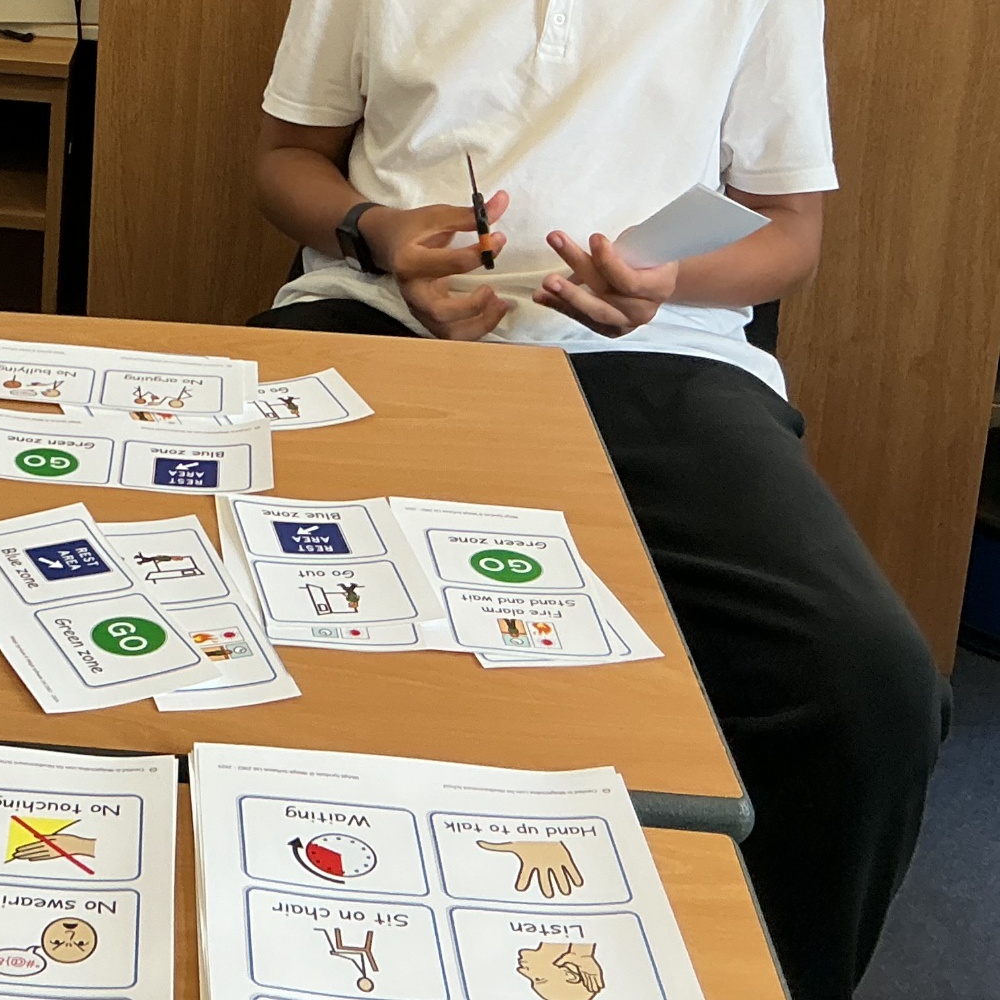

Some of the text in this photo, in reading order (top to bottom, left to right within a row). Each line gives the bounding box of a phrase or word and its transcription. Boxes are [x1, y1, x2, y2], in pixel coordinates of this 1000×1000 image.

[56, 369, 77, 378] No
[123, 373, 204, 386] No arguing
[270, 386, 289, 394] Go
[7, 434, 96, 450] Green zone
[150, 446, 225, 459] Blue zone
[23, 454, 71, 470] GO
[167, 469, 205, 478] AREA
[168, 478, 203, 486] REST
[262, 508, 341, 520] Blue zone
[292, 535, 330, 544] AREA
[448, 536, 547, 550] Green zone
[298, 544, 334, 553] REST
[56, 549, 82, 572] AREA
[75, 547, 100, 568] REST
[1, 547, 40, 590] Blue zone
[478, 557, 533, 574] GO
[298, 569, 355, 579] Go out
[461, 594, 576, 608] Stand and wait
[481, 606, 563, 619] Fire alarm
[107, 621, 148, 652] GO
[54, 617, 104, 675] Green zone
[90, 804, 121, 817] No
[285, 805, 372, 828] Waiting
[444, 821, 597, 837] Hand up to talk
[84, 900, 117, 915] No
[271, 901, 409, 927] Sit on chair
[510, 921, 585, 939] Listen
